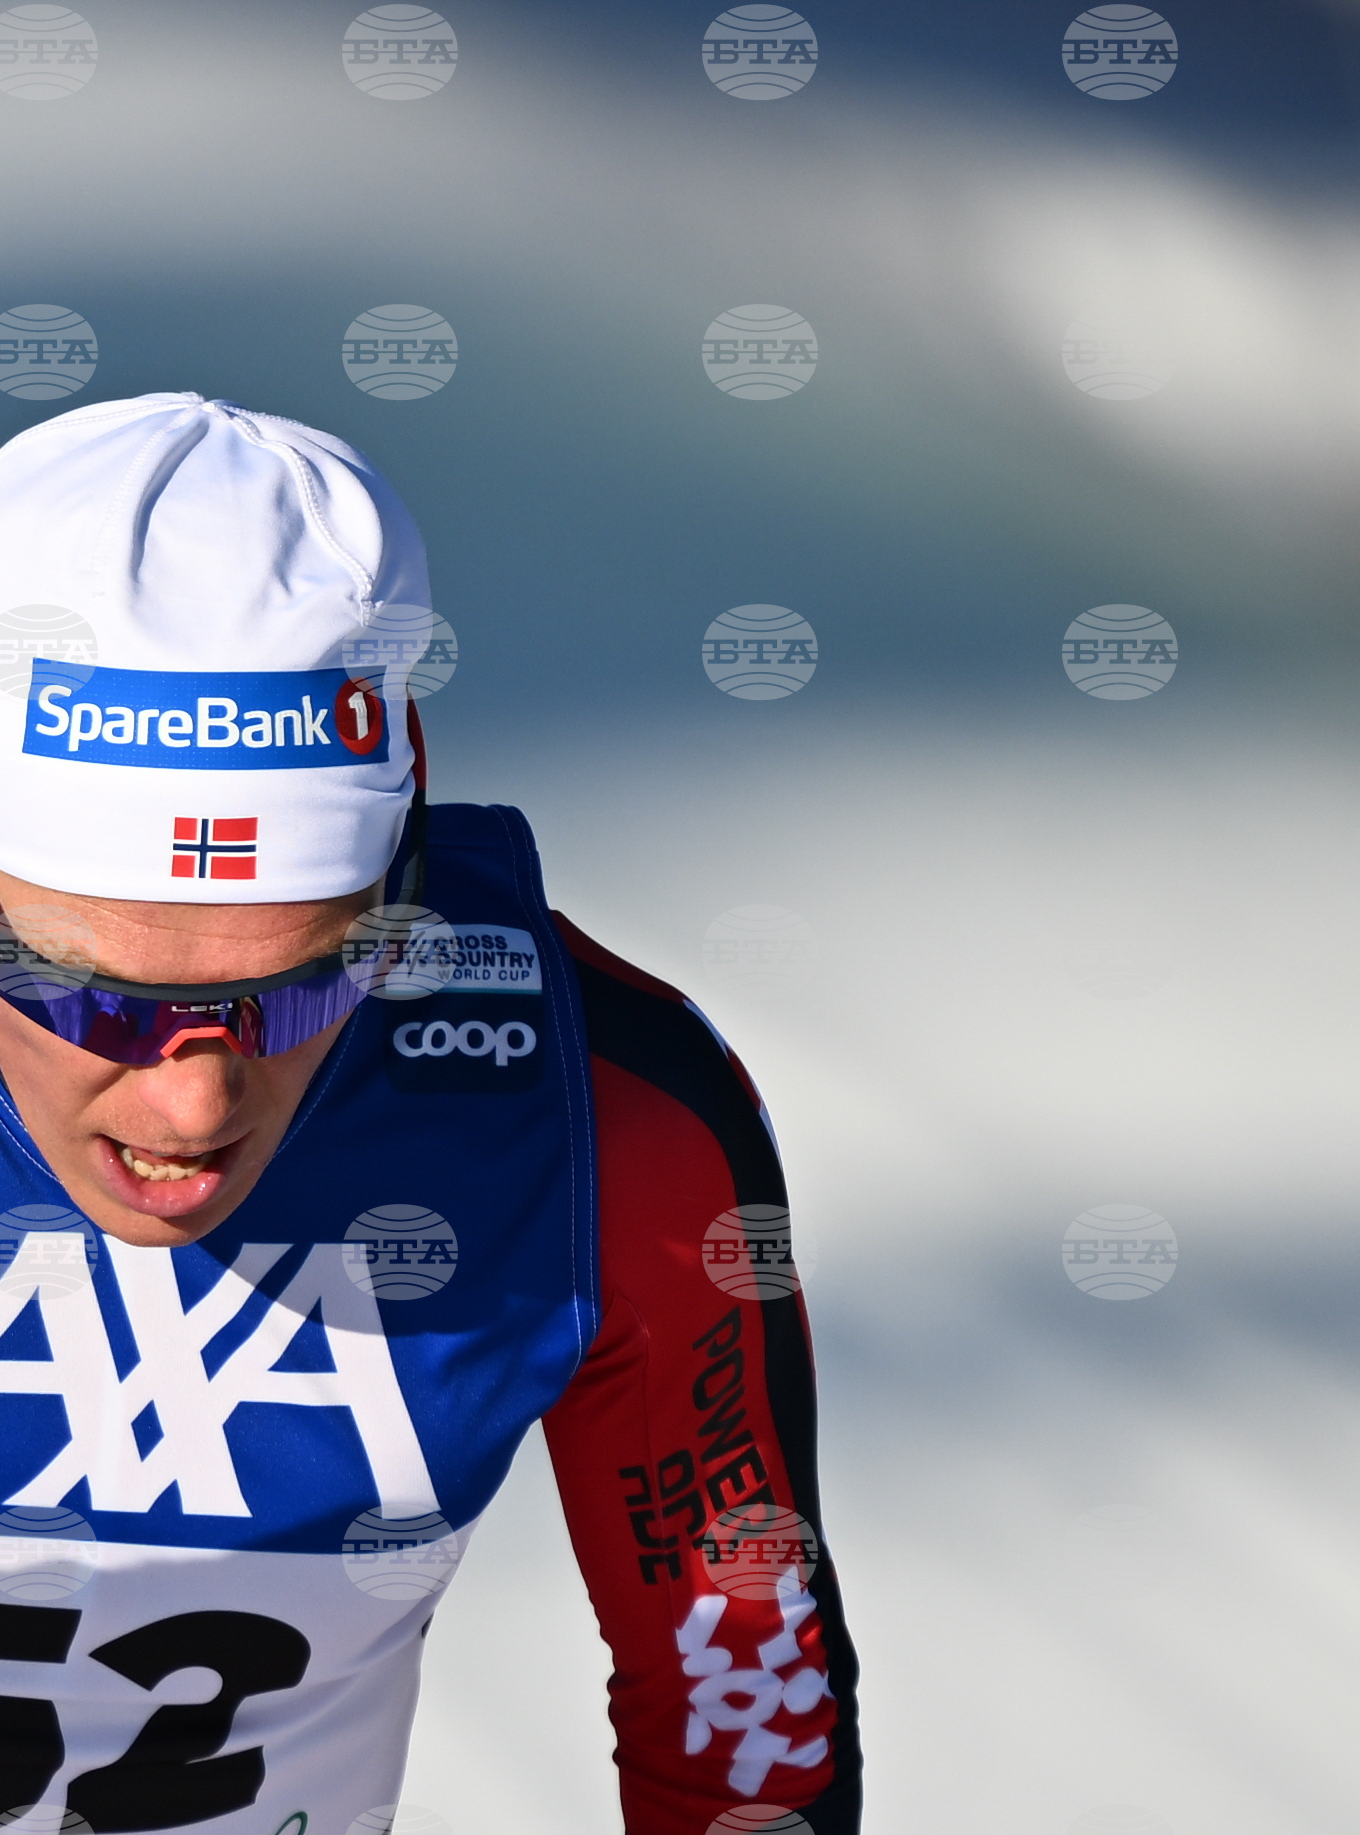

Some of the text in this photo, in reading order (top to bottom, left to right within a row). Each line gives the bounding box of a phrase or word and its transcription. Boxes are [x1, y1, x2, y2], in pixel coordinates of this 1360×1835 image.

[34, 685, 369, 752] SpareBank 1
[433, 933, 508, 951] CROSS
[437, 951, 536, 969] COUNTRY
[437, 968, 531, 982] WORLD CUP
[392, 1019, 538, 1067] coop
[691, 1304, 779, 1556] POWER
